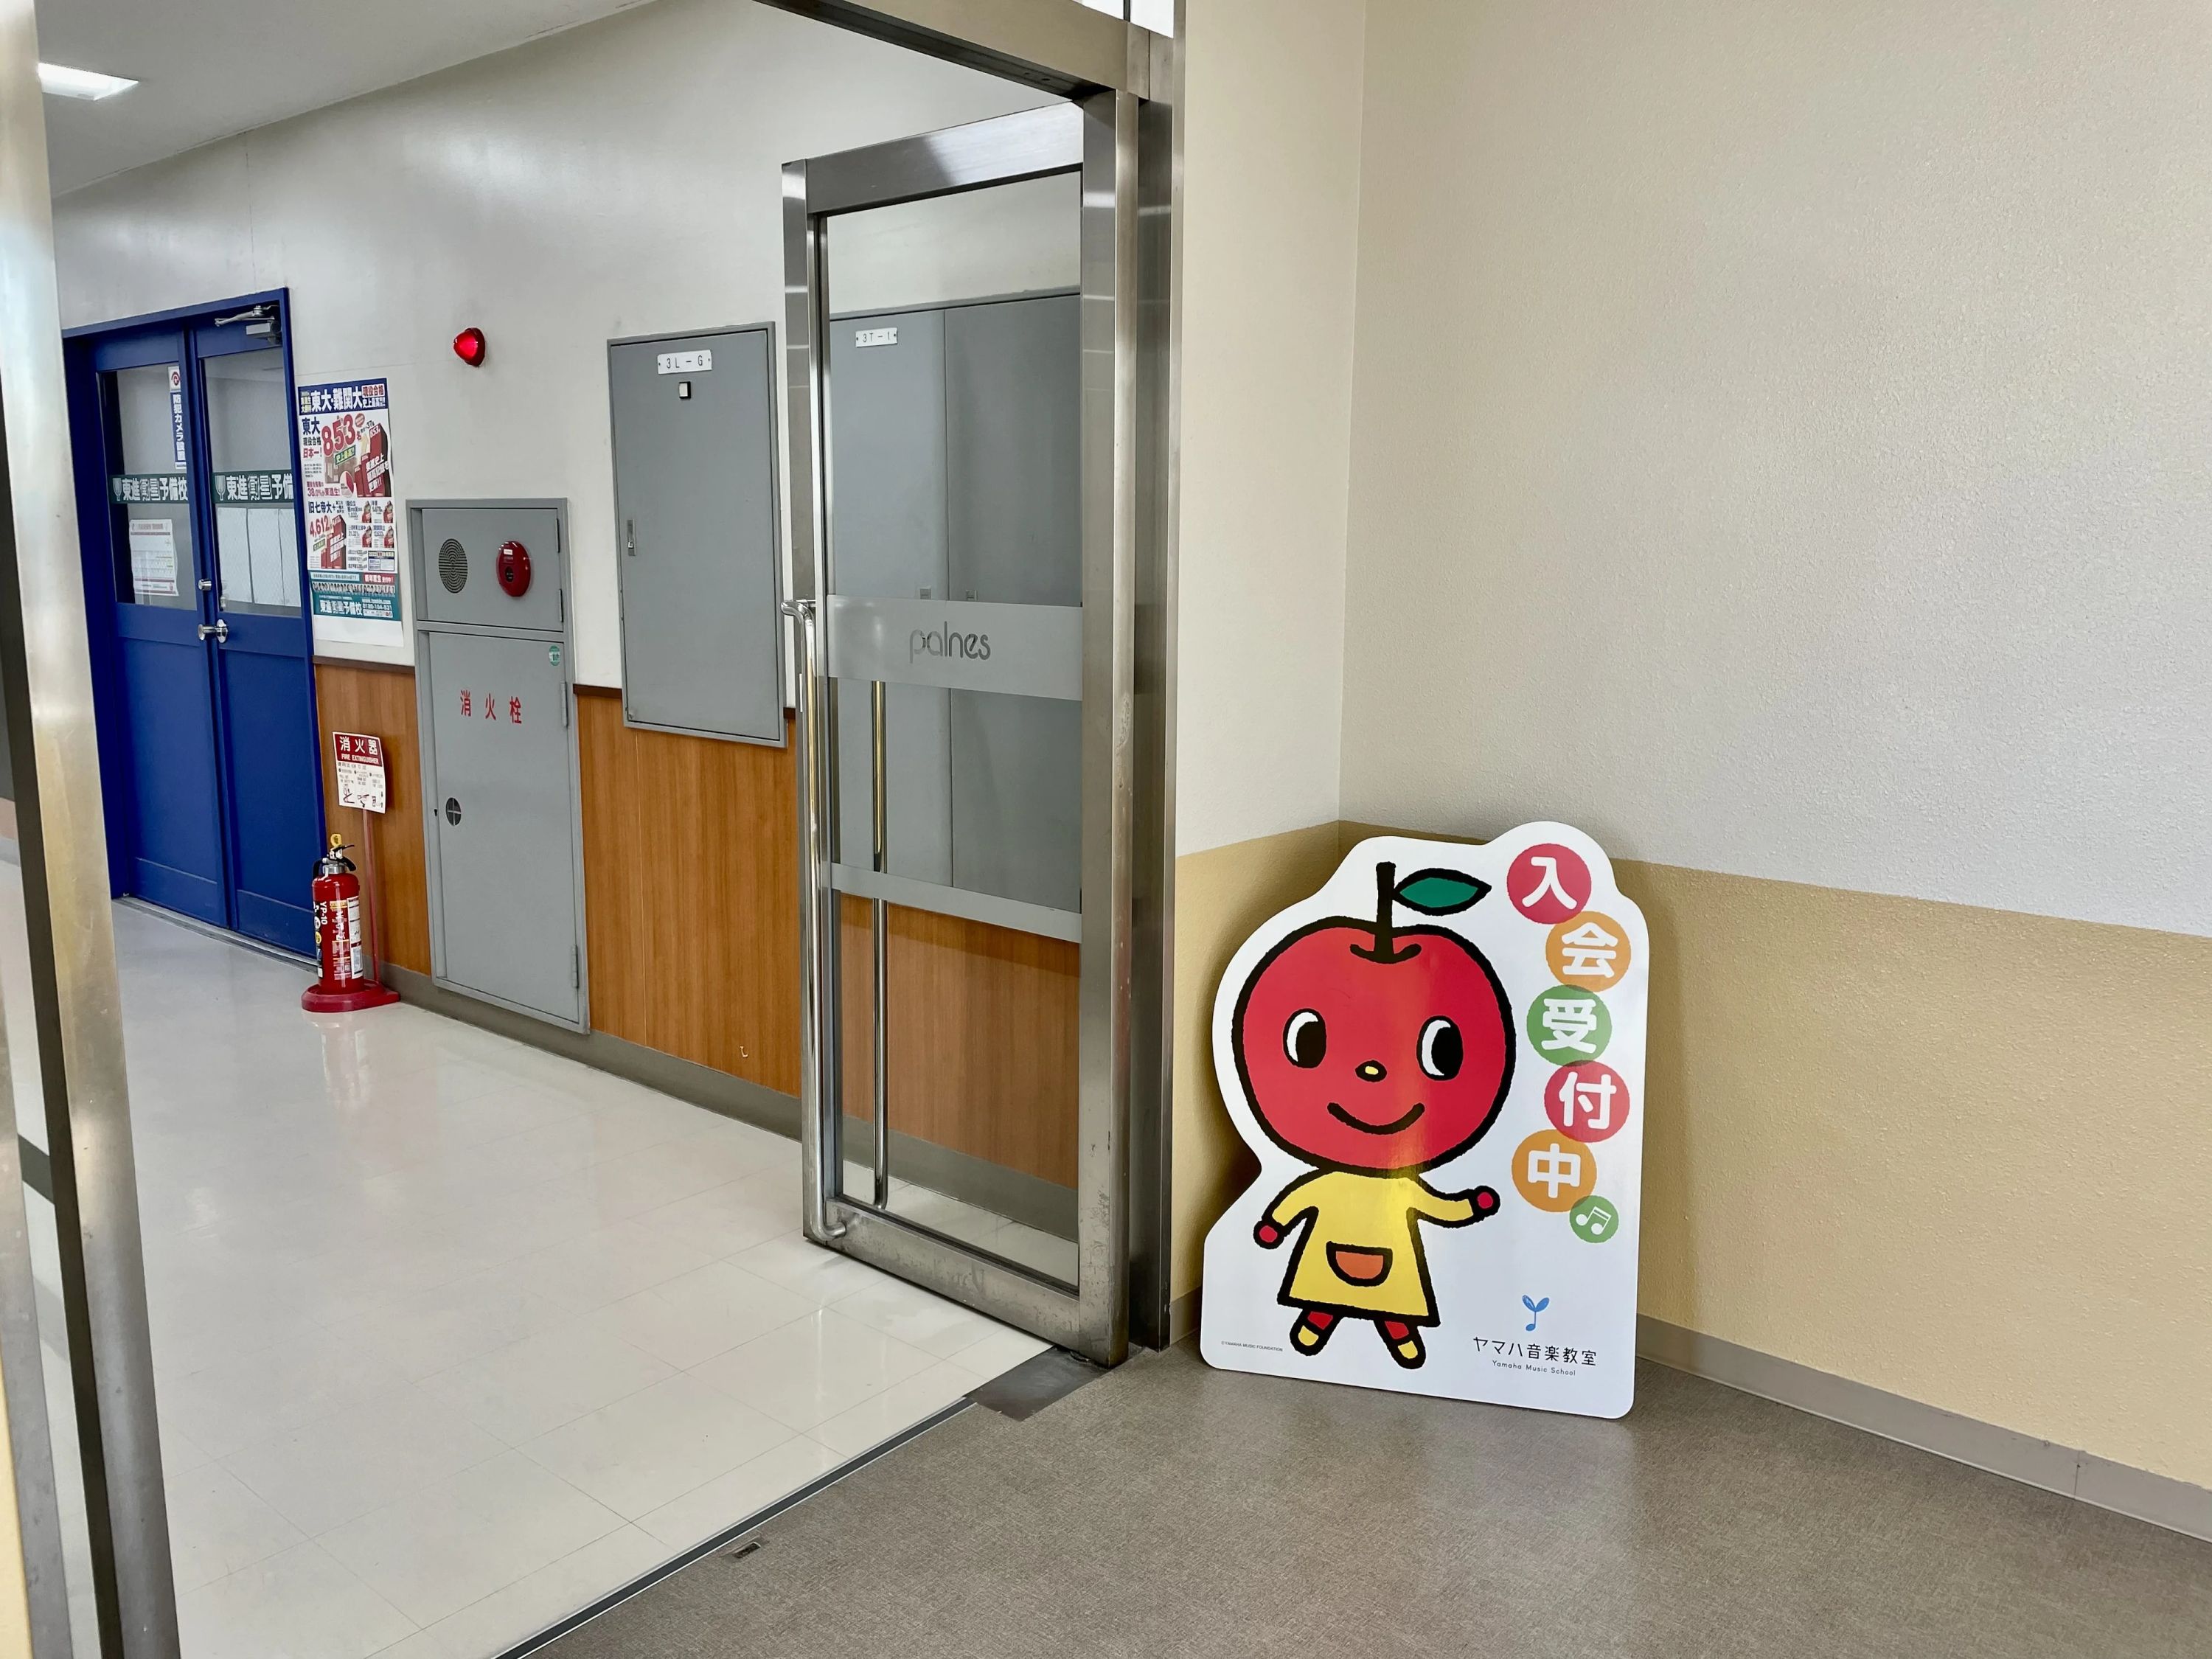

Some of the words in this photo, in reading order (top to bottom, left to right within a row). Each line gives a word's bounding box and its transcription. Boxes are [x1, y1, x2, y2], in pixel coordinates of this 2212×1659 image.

[667, 355, 703, 369] 3L-G
[302, 417, 320, 435] 東大
[122, 476, 188, 501] 東進衛星予備校
[909, 621, 991, 664] palnes
[460, 689, 522, 724] 消火栓
[339, 736, 378, 756] 消火器
[319, 901, 328, 925] YP-10
[1473, 1337, 1596, 1366] ヤマハ音楽教室
[1492, 1360, 1522, 1370] Yamaha
[1526, 1364, 1548, 1373] Music
[1551, 1367, 1576, 1377] School
